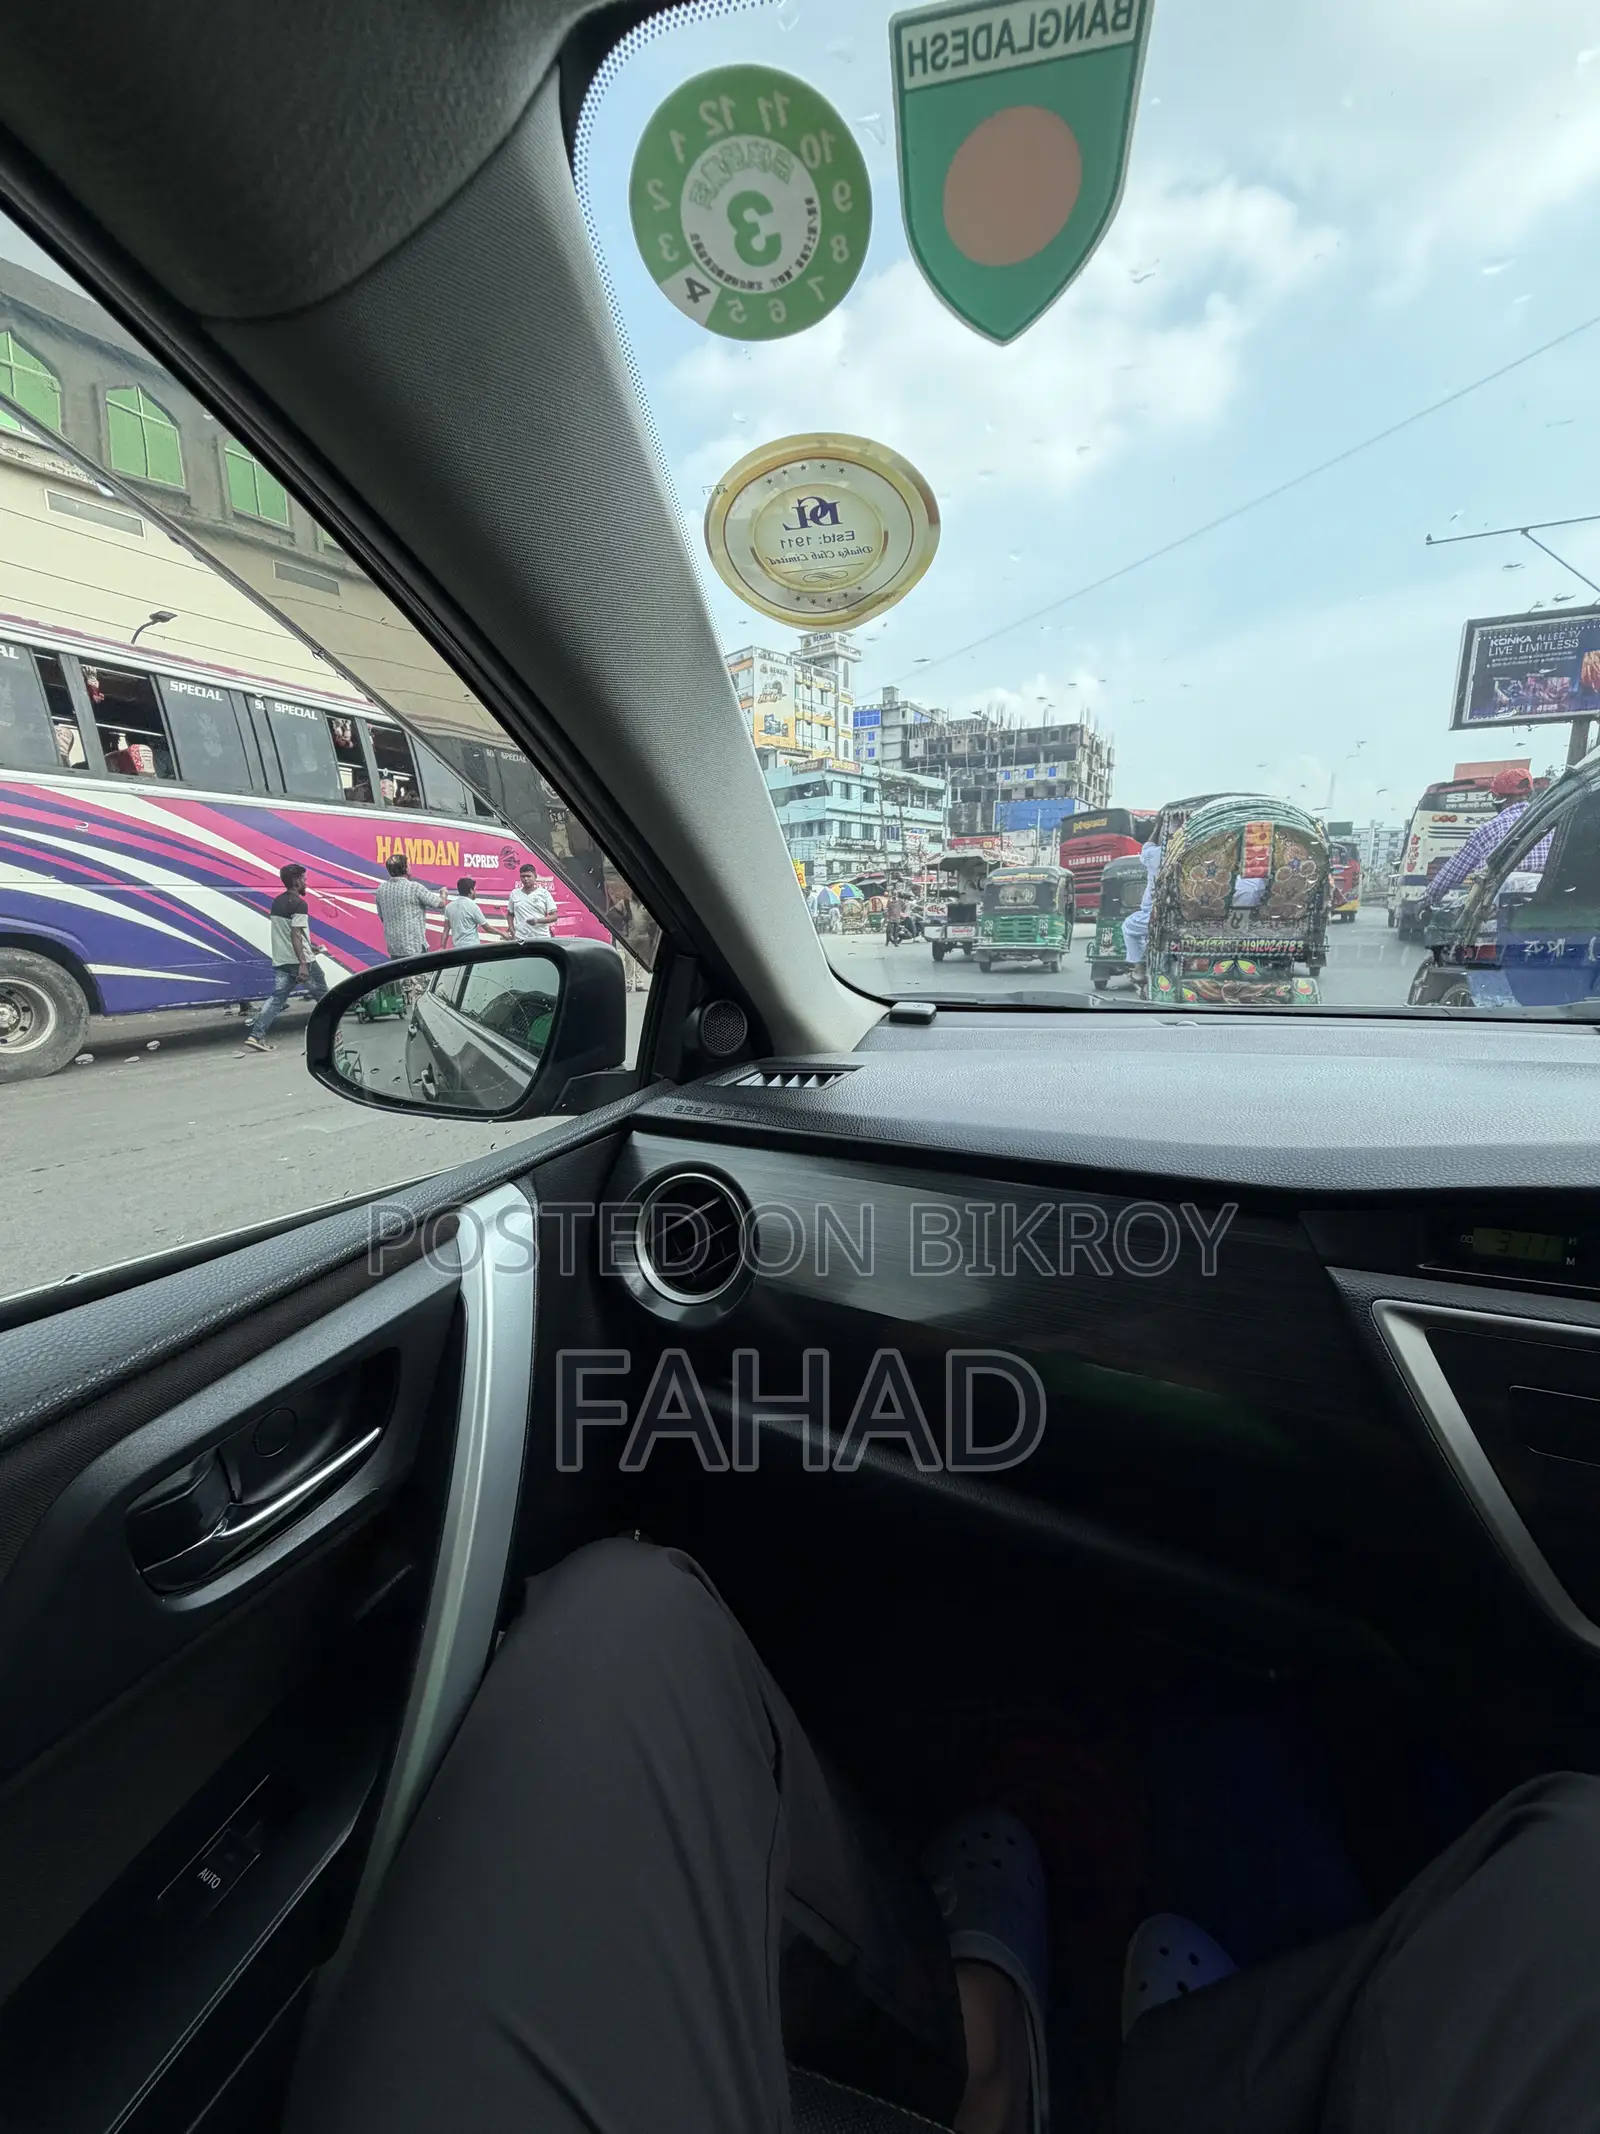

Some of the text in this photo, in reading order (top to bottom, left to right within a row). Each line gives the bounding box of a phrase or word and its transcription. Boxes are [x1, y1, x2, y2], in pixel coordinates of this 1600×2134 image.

[1488, 645, 1513, 657] LIVE
[1519, 639, 1579, 653] LIMITLESS
[1490, 635, 1532, 647] KONKA
[169, 681, 223, 701] SPECIAL
[274, 702, 318, 720] SPECIAL
[501, 751, 527, 763] SPECIAL
[376, 835, 499, 869] HAMDAN EXPRESS
[1566, 1257, 1576, 1266] M
[197, 1867, 221, 1889] AUTO
